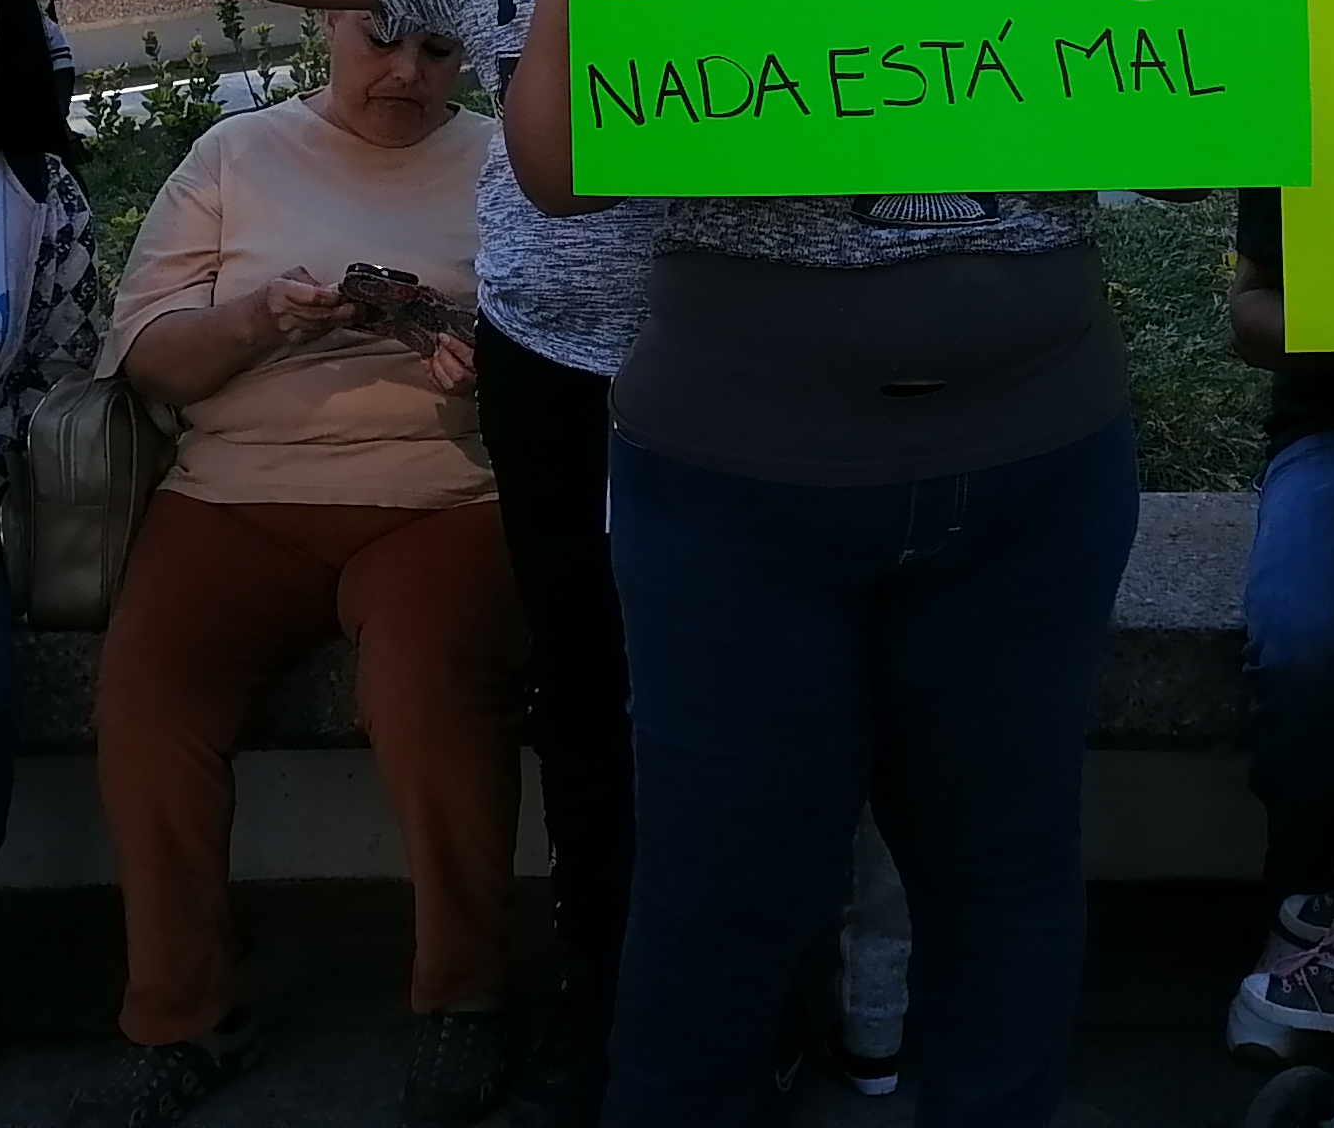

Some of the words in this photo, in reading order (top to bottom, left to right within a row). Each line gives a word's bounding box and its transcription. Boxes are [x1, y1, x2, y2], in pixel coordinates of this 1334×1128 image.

[587, 53, 811, 129] NADA
[828, 19, 1024, 119] ESTÁ
[1054, 27, 1226, 98] MAL
